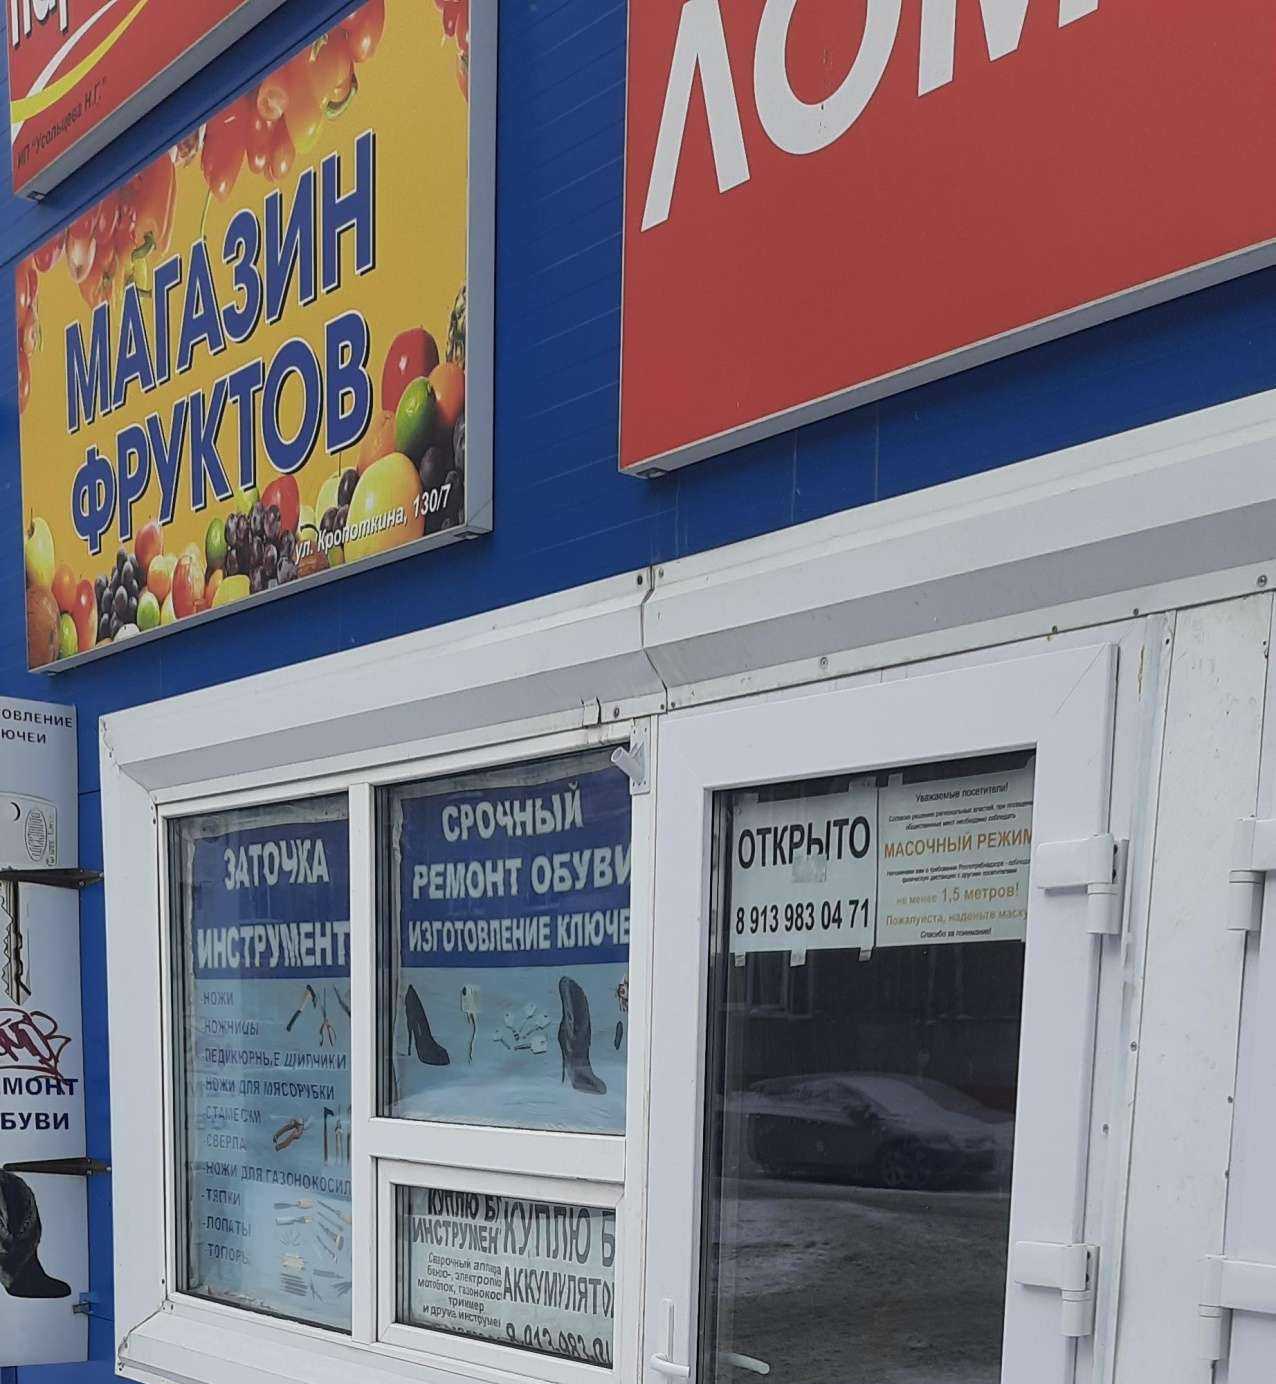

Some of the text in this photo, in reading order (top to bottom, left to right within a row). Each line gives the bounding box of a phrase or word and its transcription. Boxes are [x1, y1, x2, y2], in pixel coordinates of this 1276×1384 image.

[64, 128, 376, 434] МАГАЗИН
[71, 310, 374, 556] ФРУКТОВ
[295, 484, 451, 564] ул. Кропоткина, 130/7
[441, 781, 584, 842] СРОЧНЫЙ
[915, 790, 960, 803] Уважаемые
[738, 816, 871, 869] ОТКРЫТО
[884, 829, 1032, 859] МАСОЧНЫЙ РЕЖИМ
[223, 838, 330, 890] ЗАТОЧКА
[413, 858, 522, 900] РЕМОНТ
[942, 886, 960, 904] 1,5
[964, 882, 1020, 902] метров!
[408, 908, 631, 953] ИЗГОТОВЛЕНИЕ КЛЮЧЕ
[736, 898, 869, 935] 8 913 983 04 71
[197, 920, 351, 969] ИНСТРУМЕНТ
[239, 1080, 260, 1096] ДЛЯ
[264, 1082, 335, 1101] МЯСОРУБКИ
[241, 1166, 263, 1182] ДЛЯ
[428, 1189, 480, 1220] КУПЛЮ
[412, 1217, 501, 1255] ИНСТРУМЕН
[504, 1201, 591, 1264] КУПЛЮ
[429, 1252, 471, 1269] Сварочный
